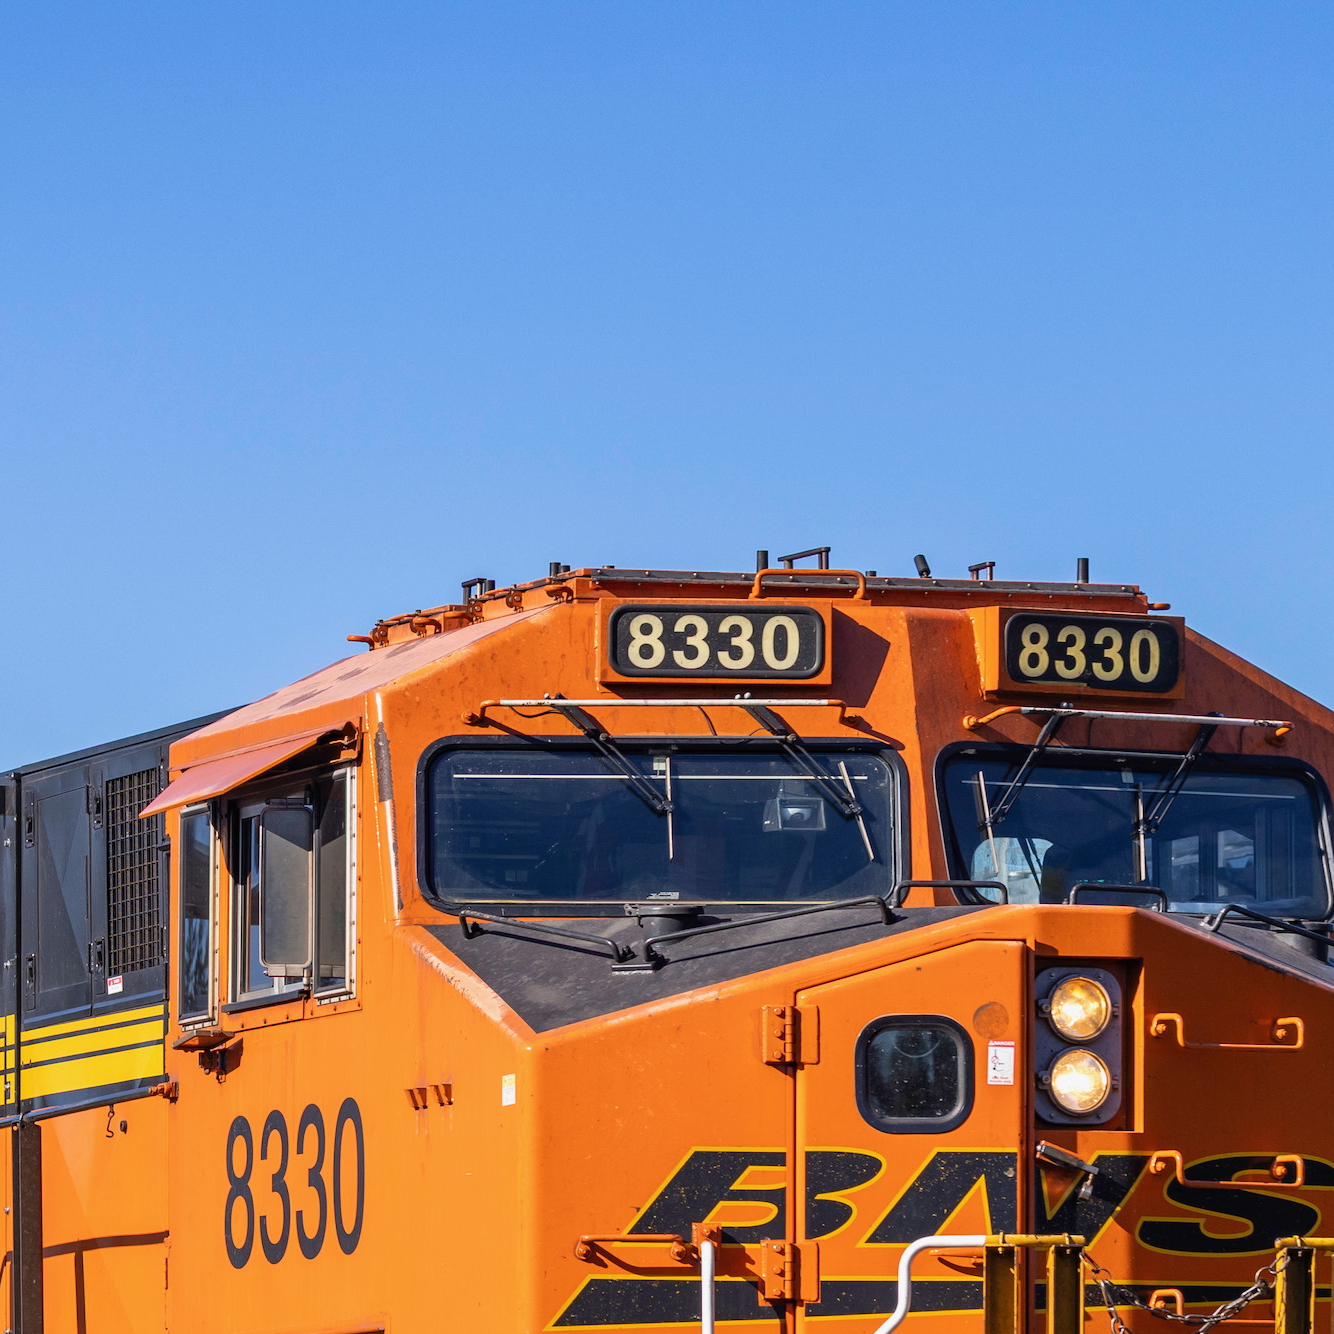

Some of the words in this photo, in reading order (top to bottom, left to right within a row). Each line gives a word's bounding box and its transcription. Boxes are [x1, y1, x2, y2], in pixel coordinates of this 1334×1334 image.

[627, 613, 800, 671] 8330
[1018, 624, 1160, 683] 8330
[224, 1097, 365, 1270] 8330
